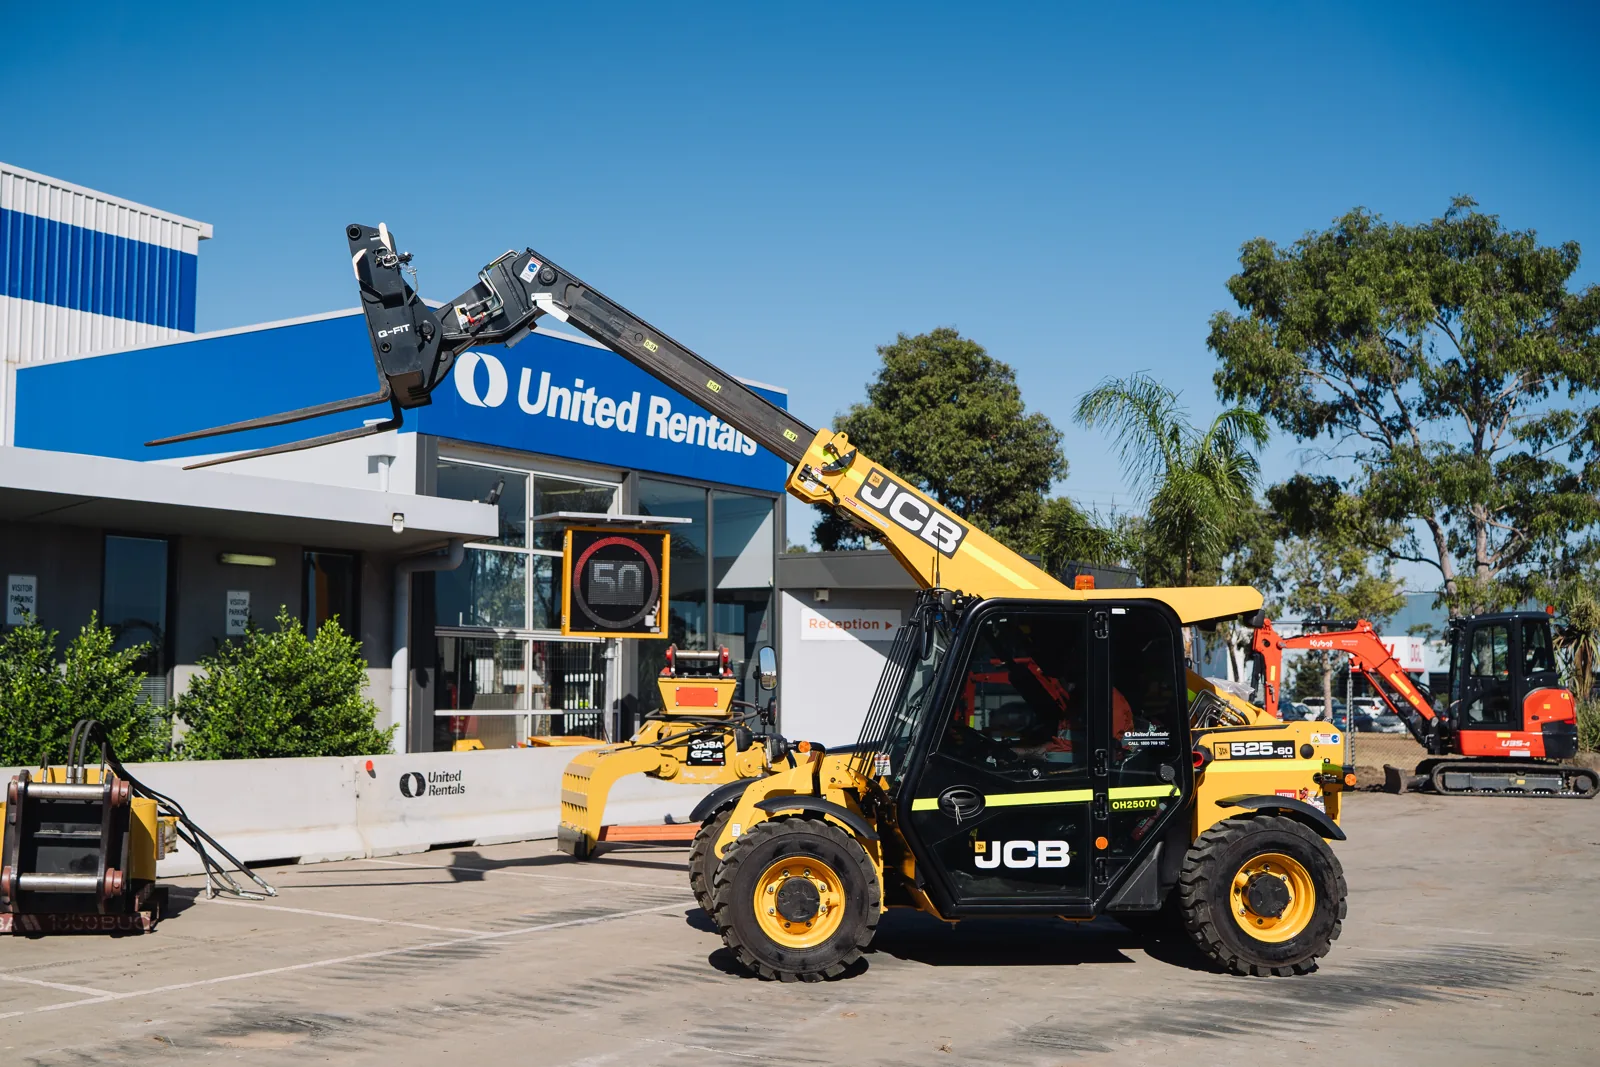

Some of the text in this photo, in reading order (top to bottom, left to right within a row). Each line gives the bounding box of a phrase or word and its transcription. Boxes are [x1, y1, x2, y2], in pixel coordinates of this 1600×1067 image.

[378, 323, 410, 338] Q-FIT
[517, 367, 757, 456] United Rentals
[860, 482, 962, 553] JCB
[12, 584, 33, 592] VISITOR
[809, 619, 879, 630] Reception
[1231, 742, 1293, 756] 525-60
[428, 770, 462, 783] United
[428, 783, 465, 796] Rentals
[1112, 799, 1157, 809] OH25070
[974, 840, 1071, 869] JCB
